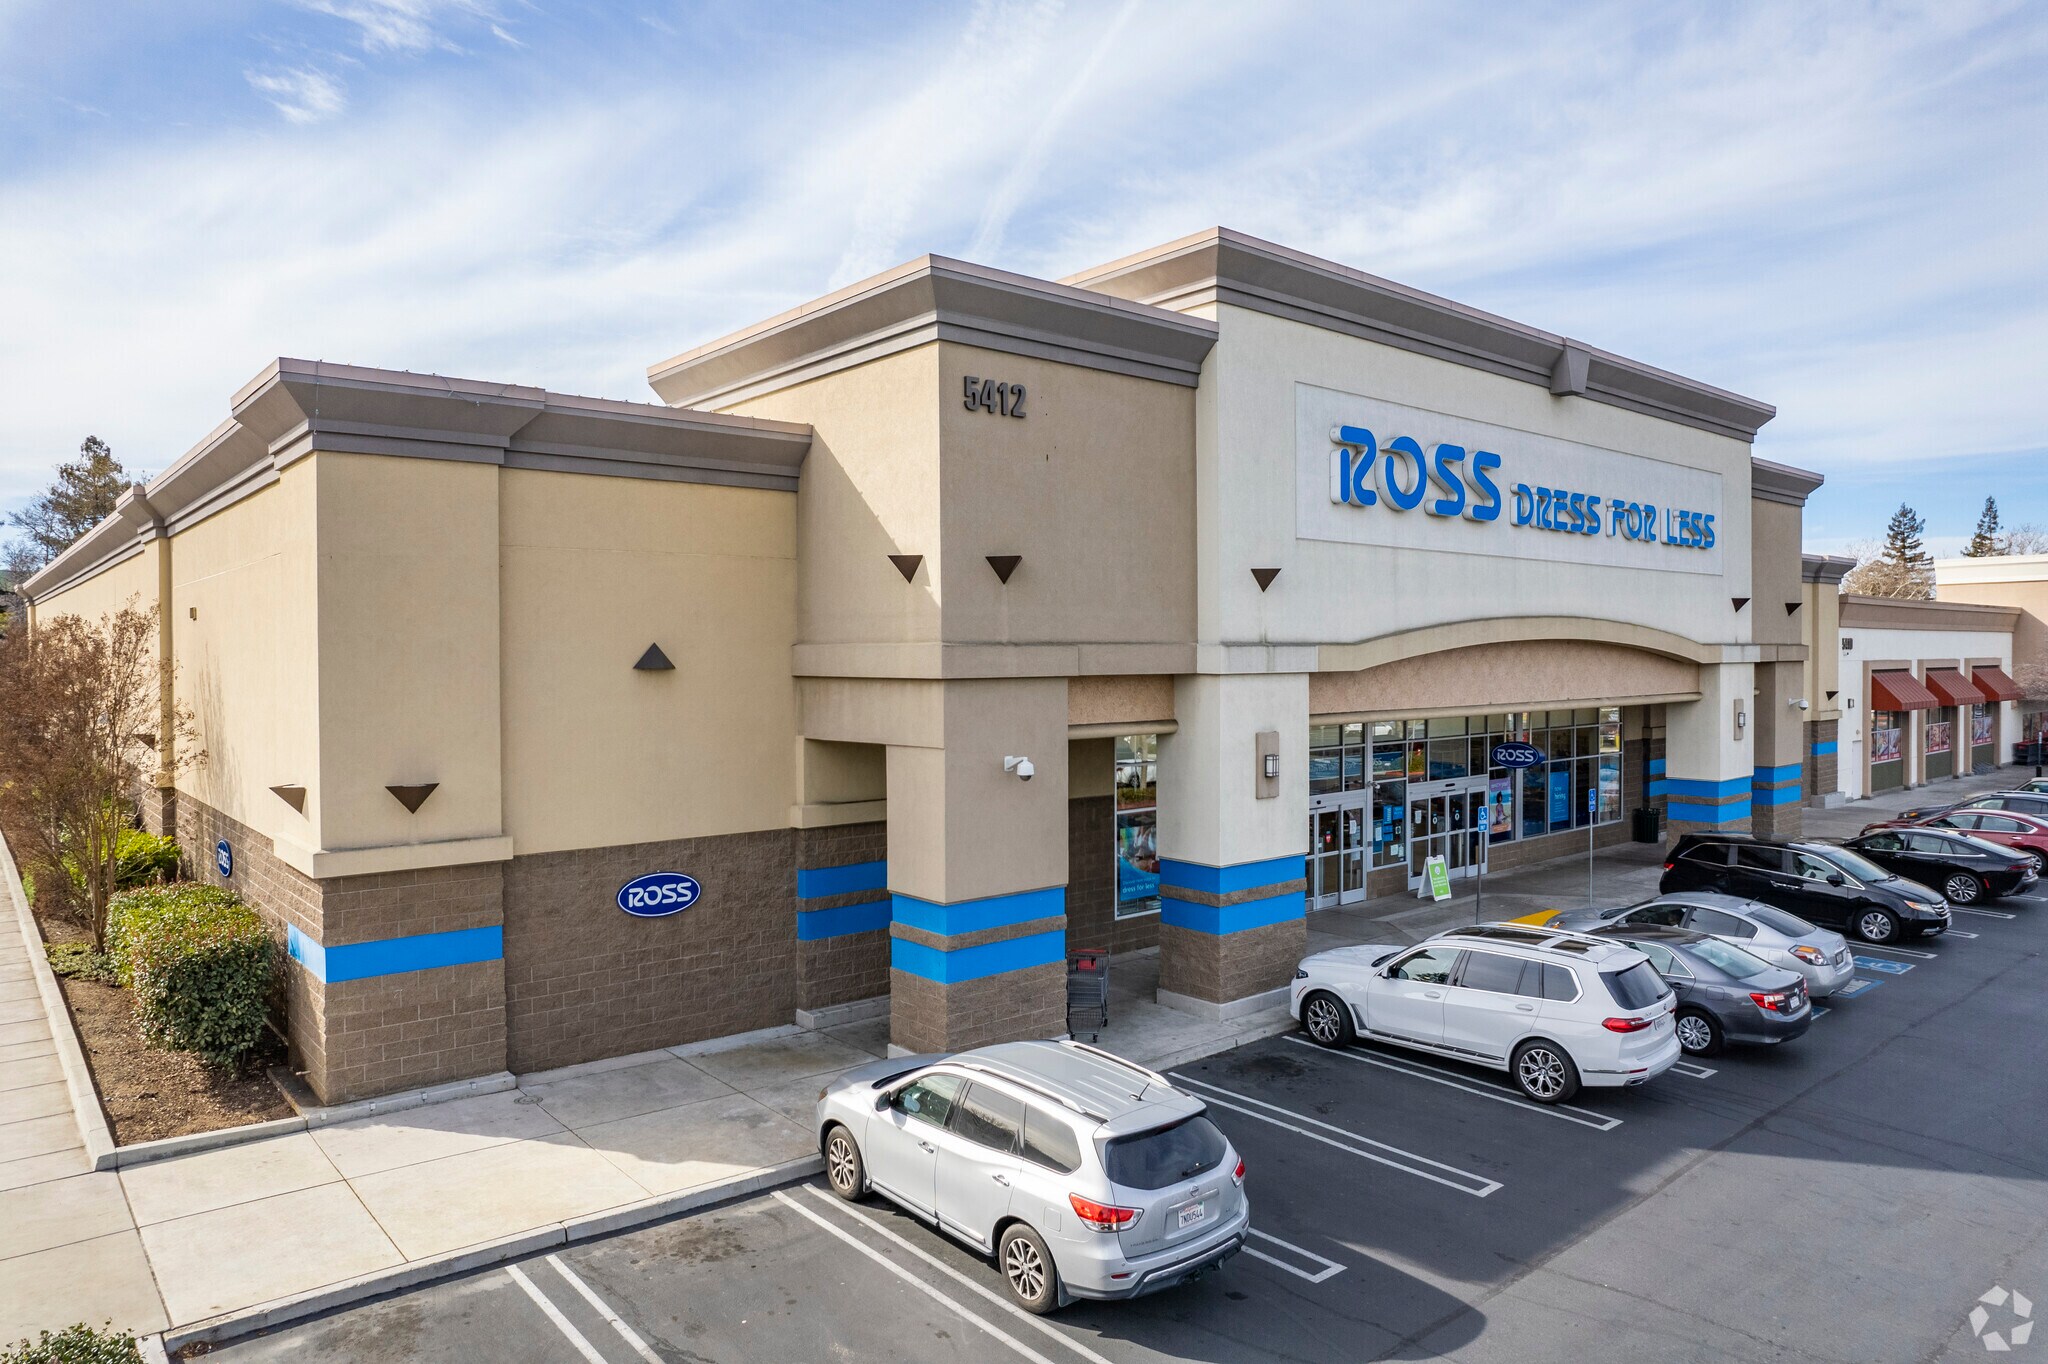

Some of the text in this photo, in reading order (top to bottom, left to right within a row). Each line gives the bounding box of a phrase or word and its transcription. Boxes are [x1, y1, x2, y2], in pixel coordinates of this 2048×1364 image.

[963, 375, 1027, 418] 5412
[1331, 425, 1716, 549] ROSS DRESS FOR LESS
[1497, 748, 1534, 762] ROSS
[628, 881, 692, 908] ROSS
